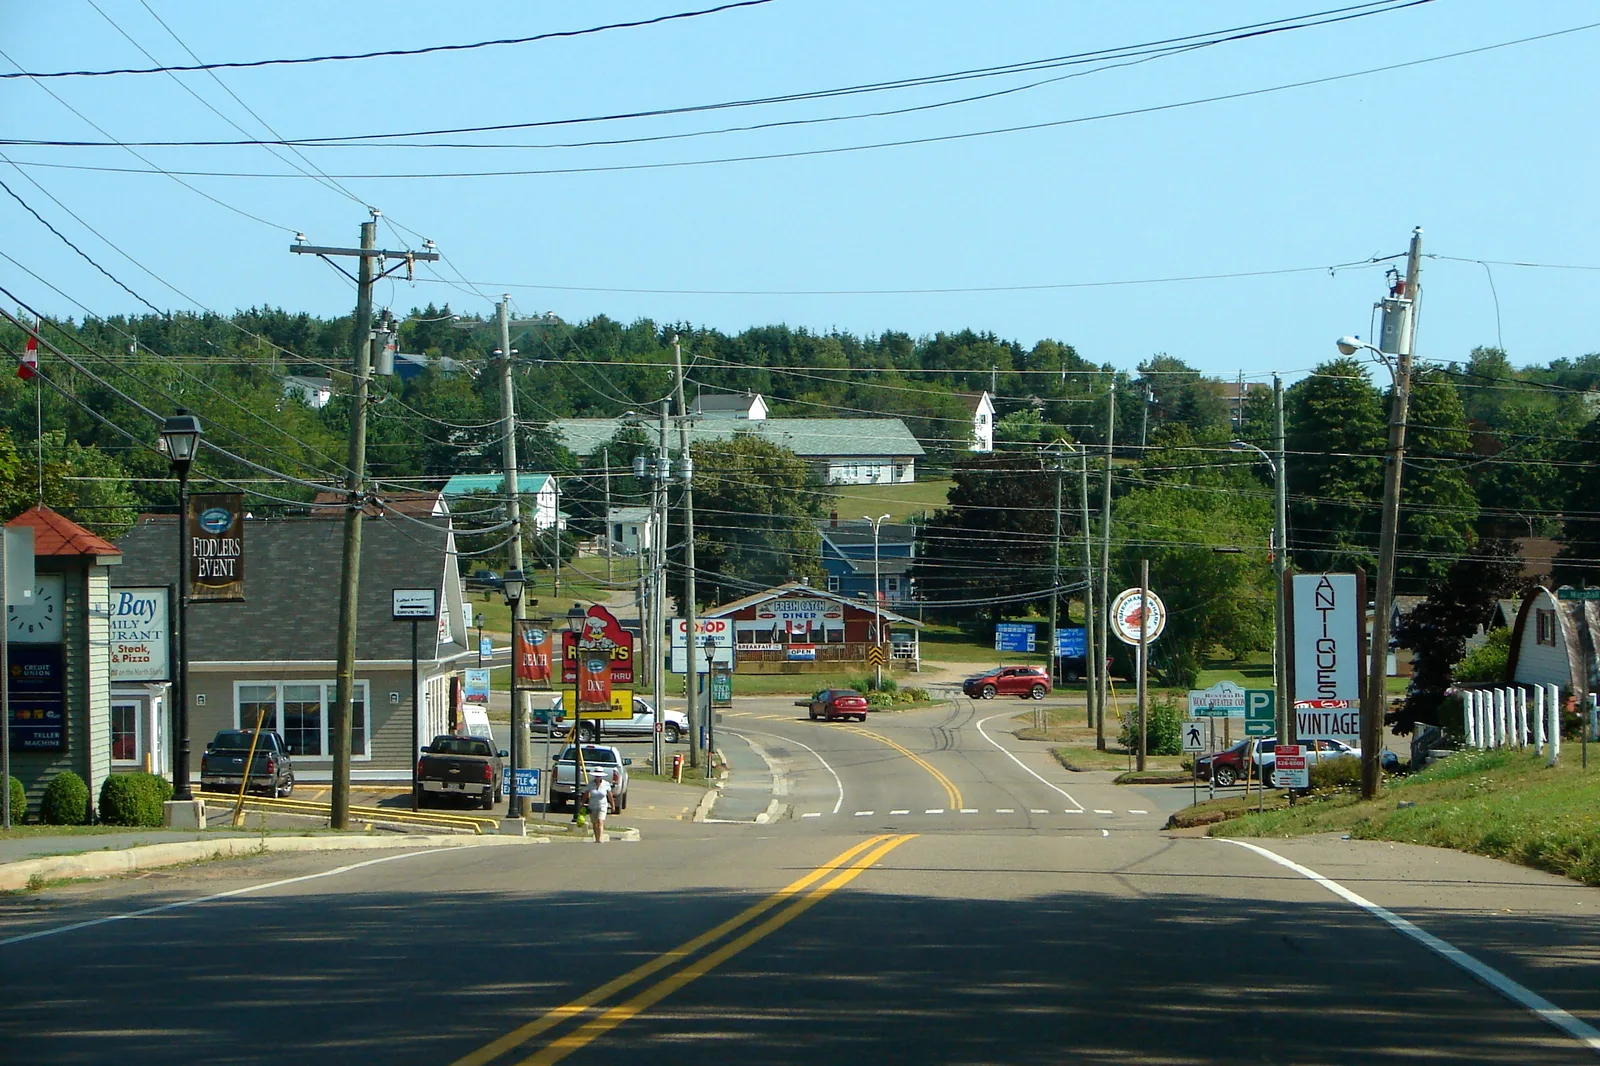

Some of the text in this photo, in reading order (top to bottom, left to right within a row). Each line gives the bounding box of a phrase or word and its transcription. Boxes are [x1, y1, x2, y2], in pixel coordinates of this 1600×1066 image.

[192, 537, 241, 557] FIDDLERS
[198, 558, 236, 577] EVENT
[117, 592, 157, 624] Bay
[774, 601, 826, 612] FRESH CATCH
[1315, 576, 1337, 700] ANTIQUES
[111, 654, 151, 663] & Pizza
[118, 644, 151, 655] Steak,
[523, 654, 547, 666] BEACH
[587, 680, 604, 691] DINE
[1250, 692, 1270, 718] P
[1297, 713, 1359, 735] VINTAGE
